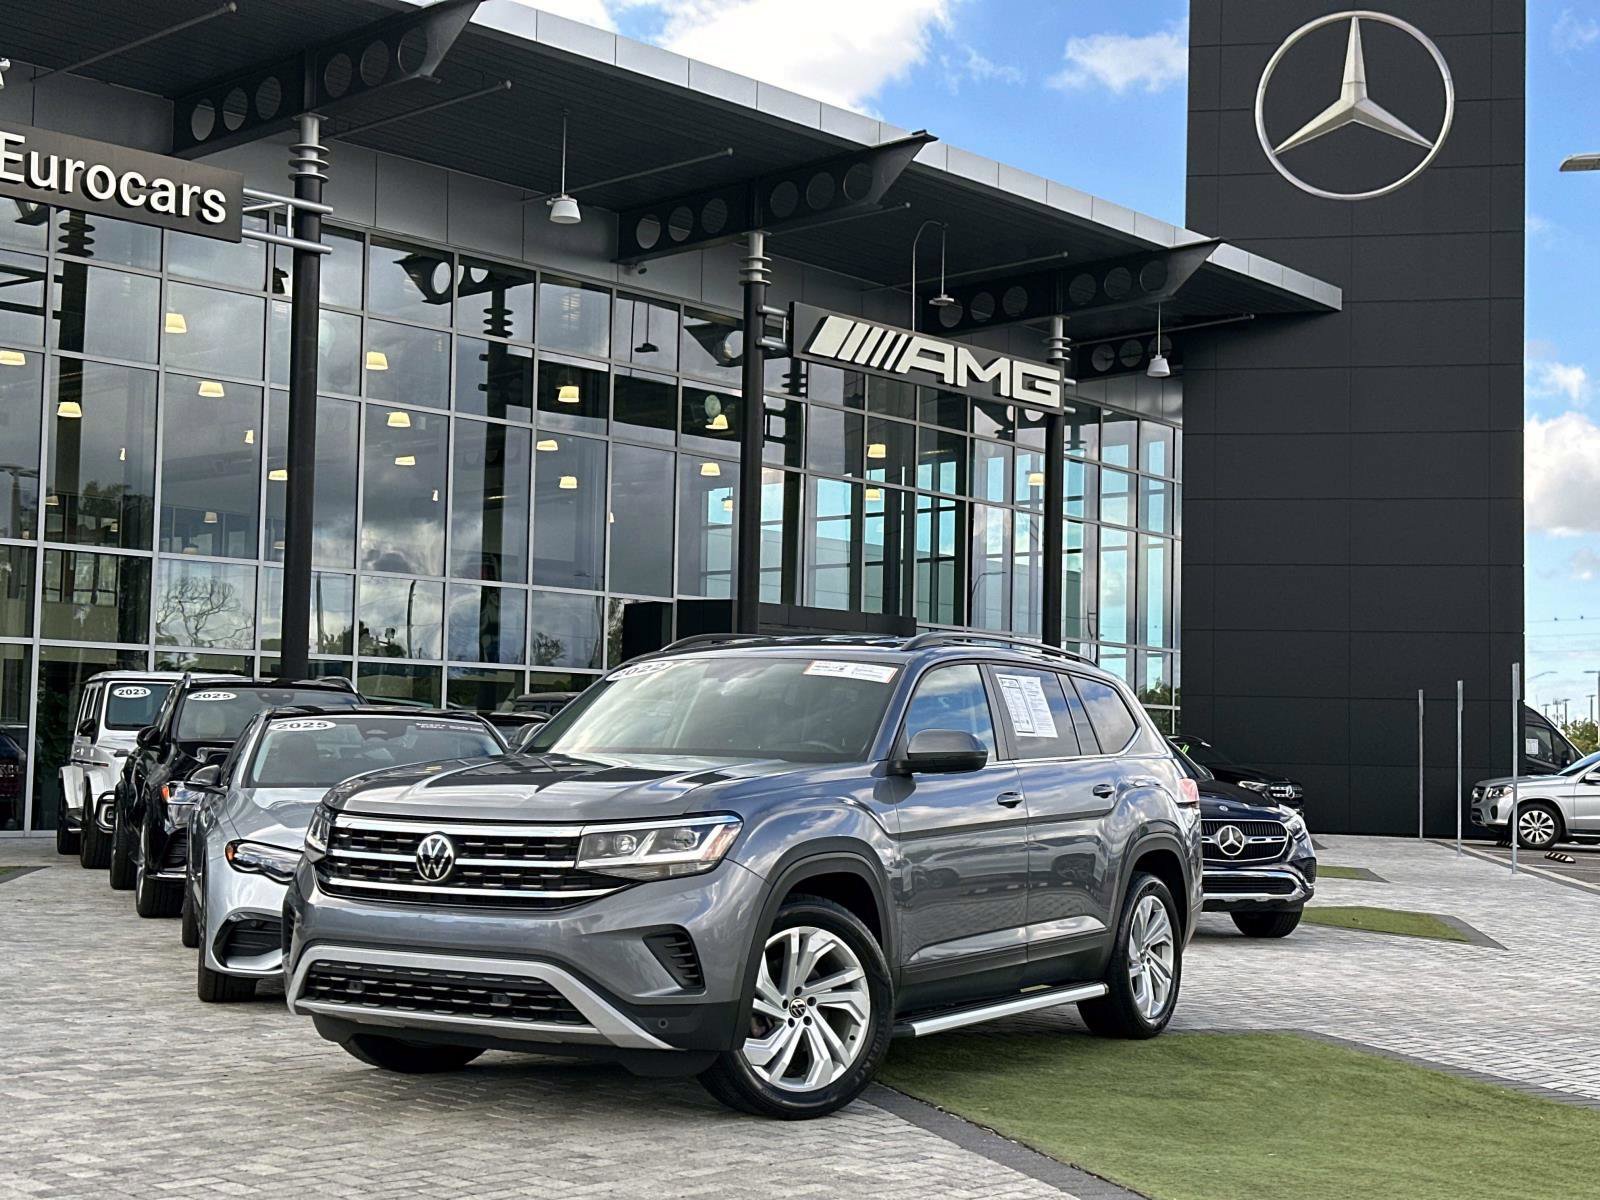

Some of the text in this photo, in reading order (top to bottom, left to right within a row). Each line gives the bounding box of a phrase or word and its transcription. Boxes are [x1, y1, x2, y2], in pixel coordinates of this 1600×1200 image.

[0, 130, 227, 223] Eurocars
[895, 335, 1061, 408] AMG
[117, 688, 147, 696] 2023
[276, 721, 328, 730] 2025
